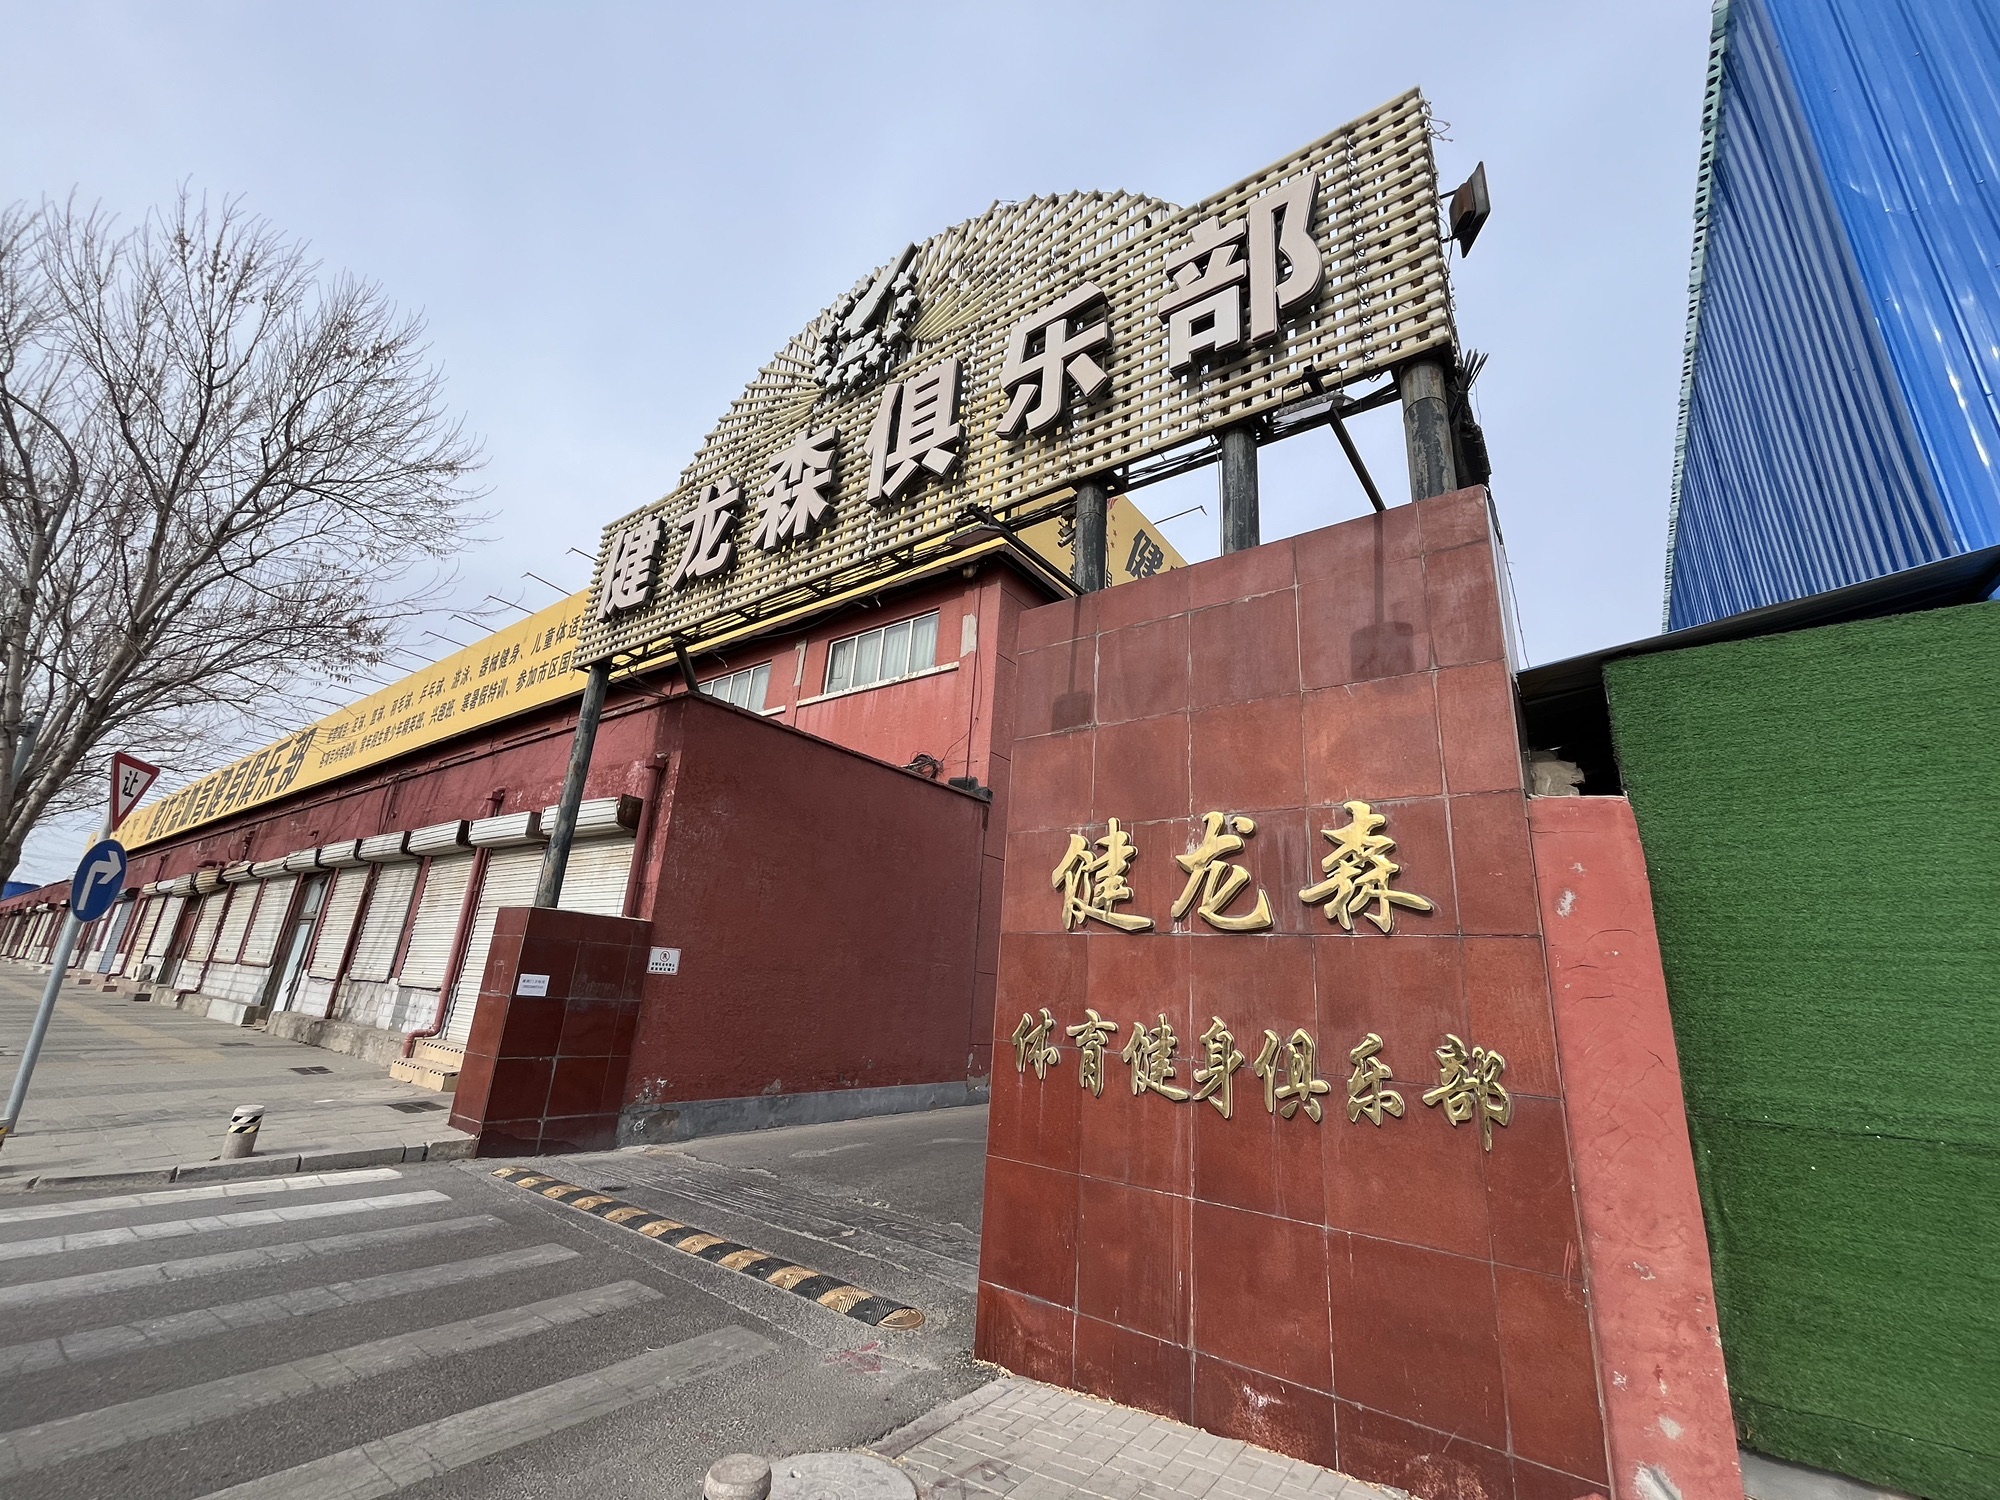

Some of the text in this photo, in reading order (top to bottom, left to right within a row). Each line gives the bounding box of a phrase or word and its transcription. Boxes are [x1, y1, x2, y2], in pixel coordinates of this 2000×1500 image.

[600, 172, 1325, 620] 健龙森俱乐部
[122, 770, 139, 798] 让
[1051, 801, 1433, 933] 健龙森
[1011, 1007, 1512, 1152] 体育健身俱乐部
